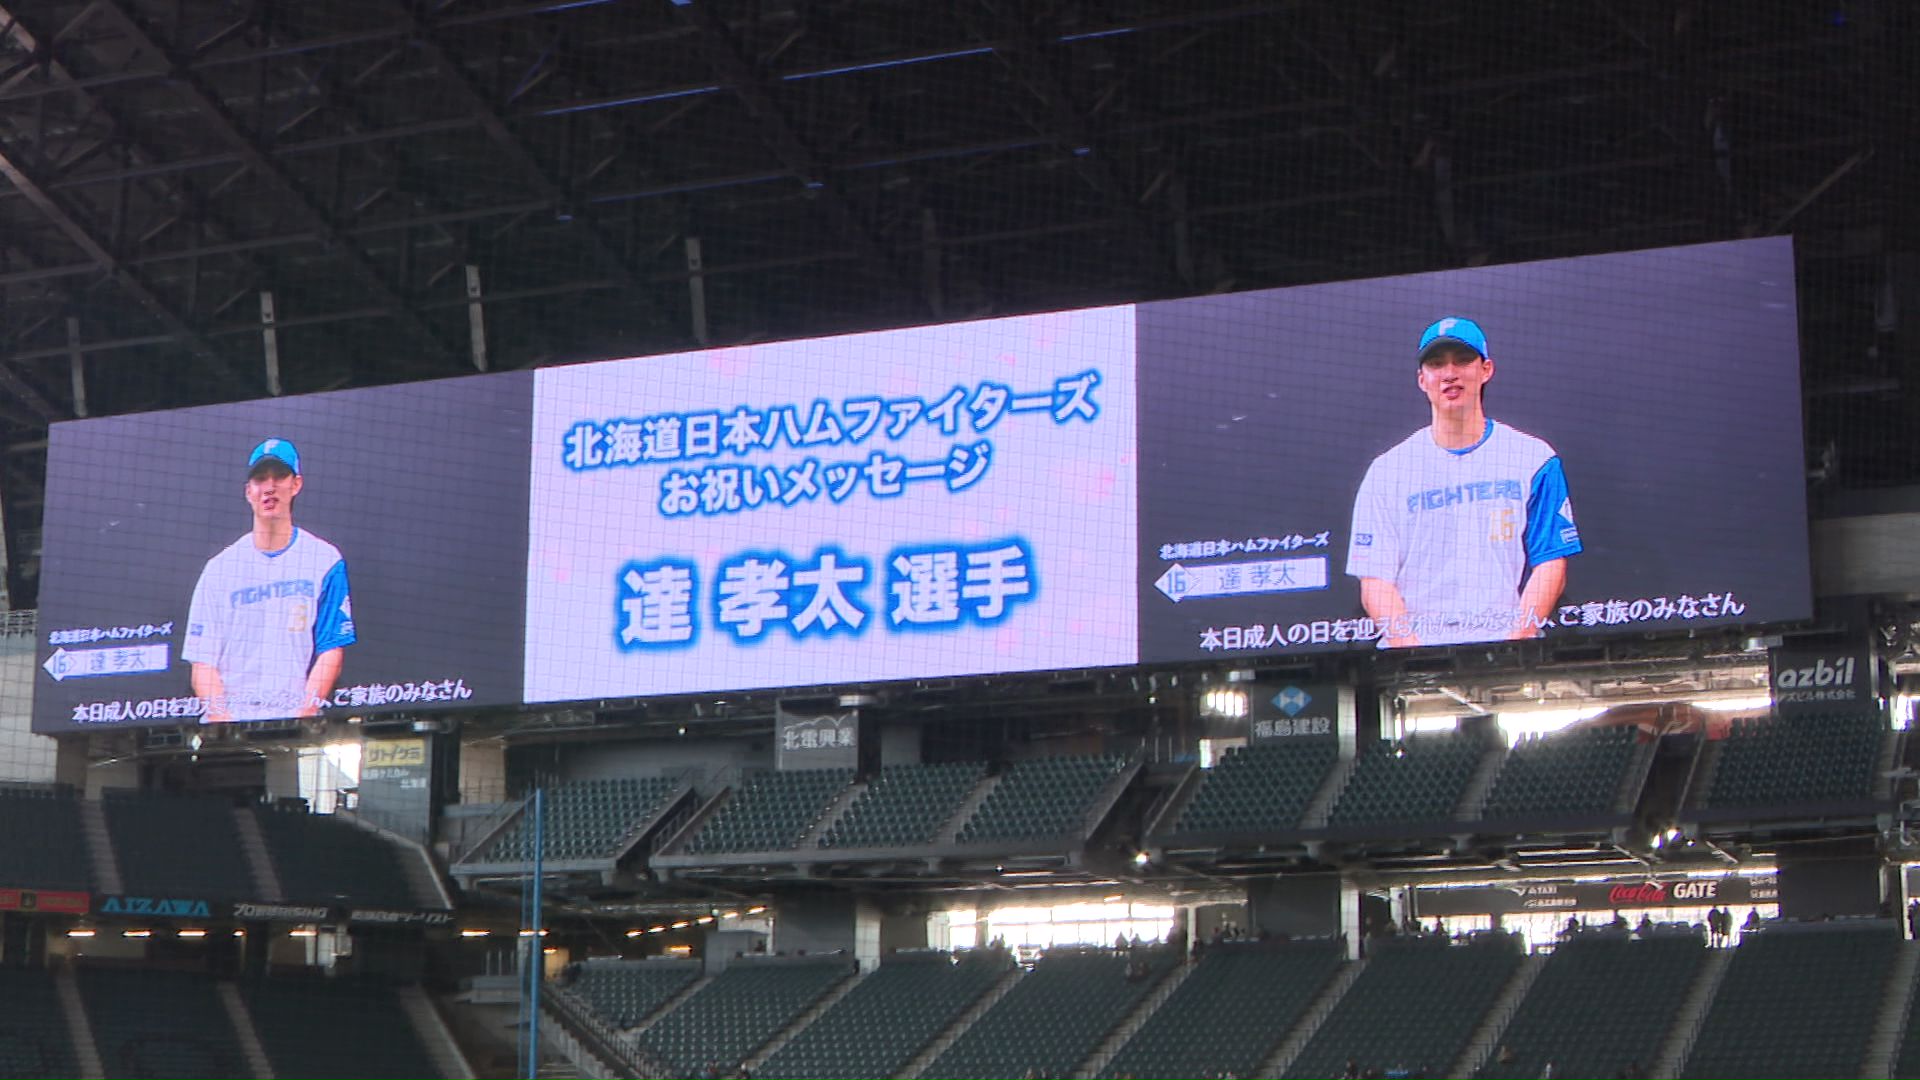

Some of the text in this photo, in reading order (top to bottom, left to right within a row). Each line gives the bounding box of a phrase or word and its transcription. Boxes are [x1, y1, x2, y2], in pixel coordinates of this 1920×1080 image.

[564, 372, 1099, 470] 北海道日本ハムファイターズ
[660, 442, 991, 515] お祝いメッセージ
[717, 552, 867, 639] 孝太
[889, 543, 1031, 627] 選手
[1167, 571, 1187, 594] 16
[1777, 657, 1855, 688] azbil
[1673, 881, 1718, 899] GATE
